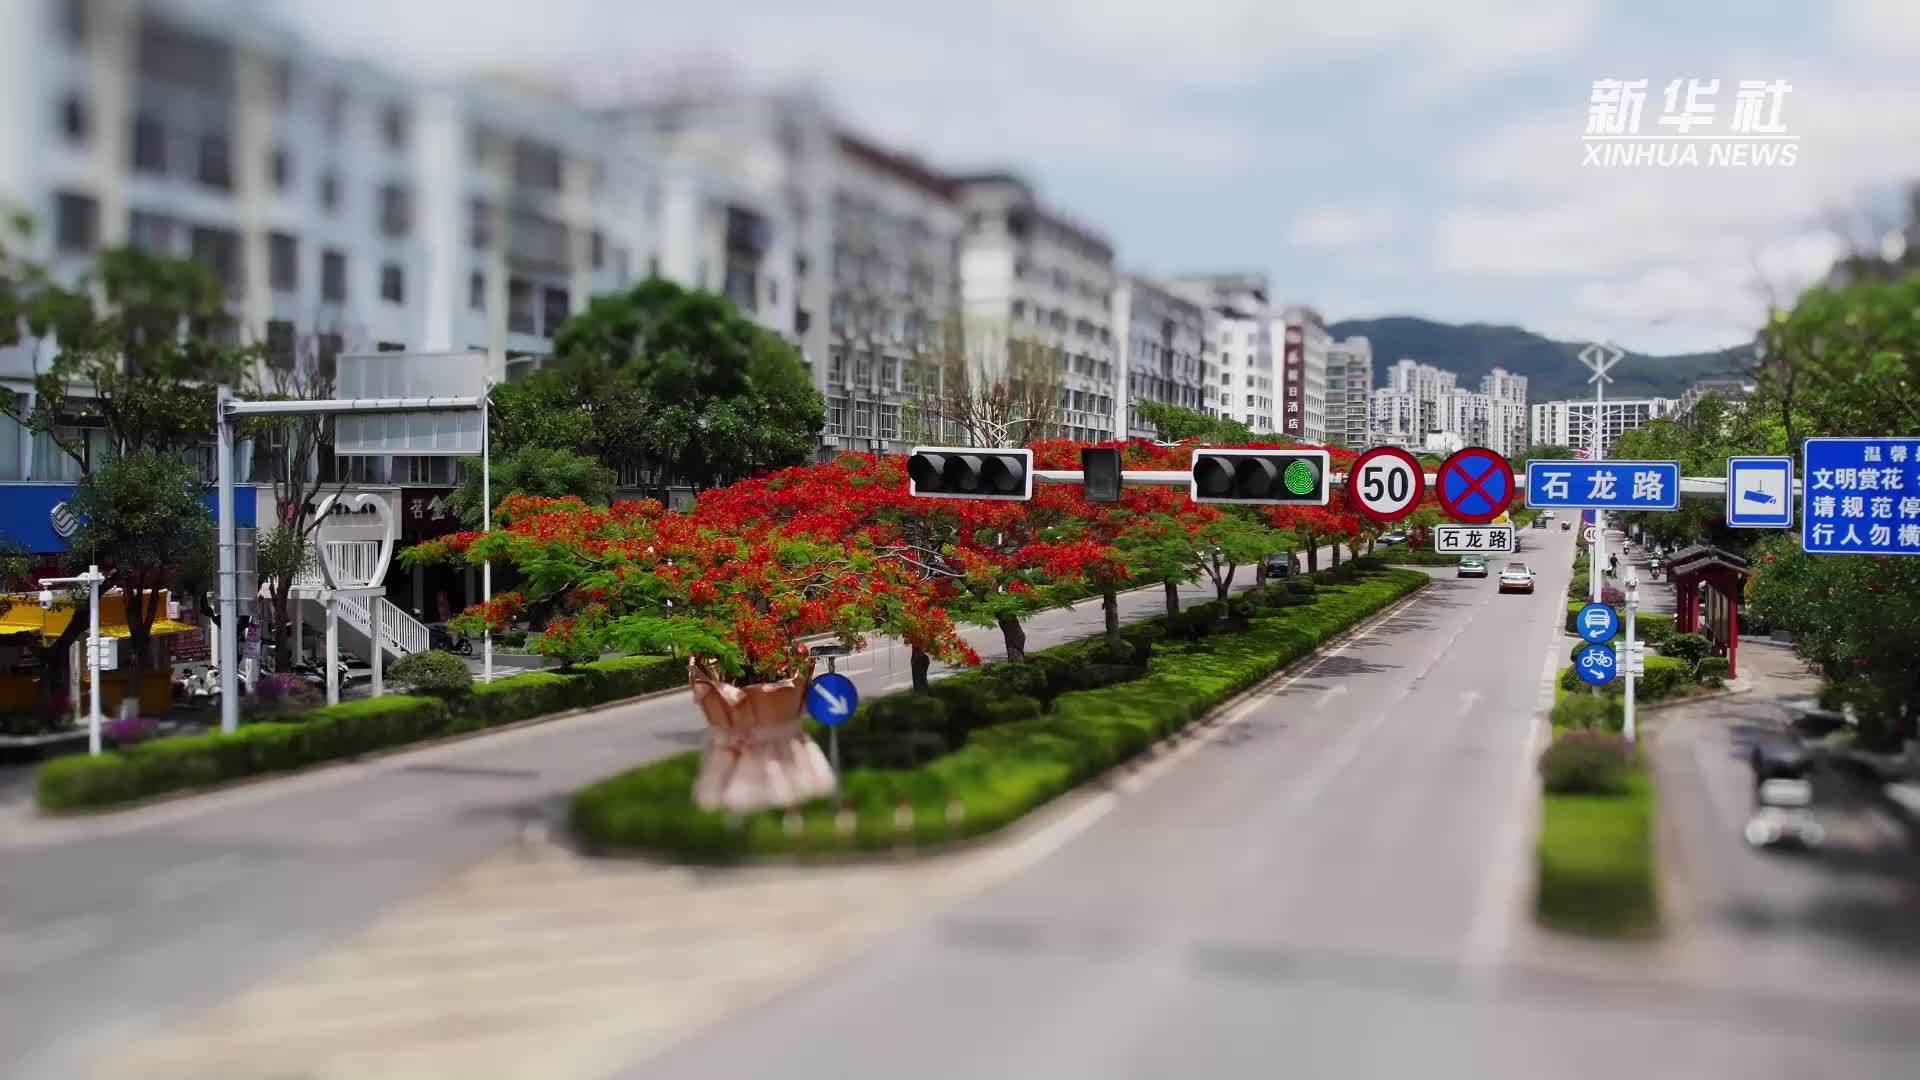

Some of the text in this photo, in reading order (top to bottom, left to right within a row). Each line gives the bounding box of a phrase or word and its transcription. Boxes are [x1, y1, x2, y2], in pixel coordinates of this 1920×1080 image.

[1364, 466, 1409, 503] 50
[1541, 470, 1665, 501] 石龙路
[1812, 467, 1904, 490] 文明赏花
[1813, 495, 1920, 519] 请规范停
[1442, 530, 1507, 548] 石龙路
[1812, 523, 1920, 547] 行人勿横
